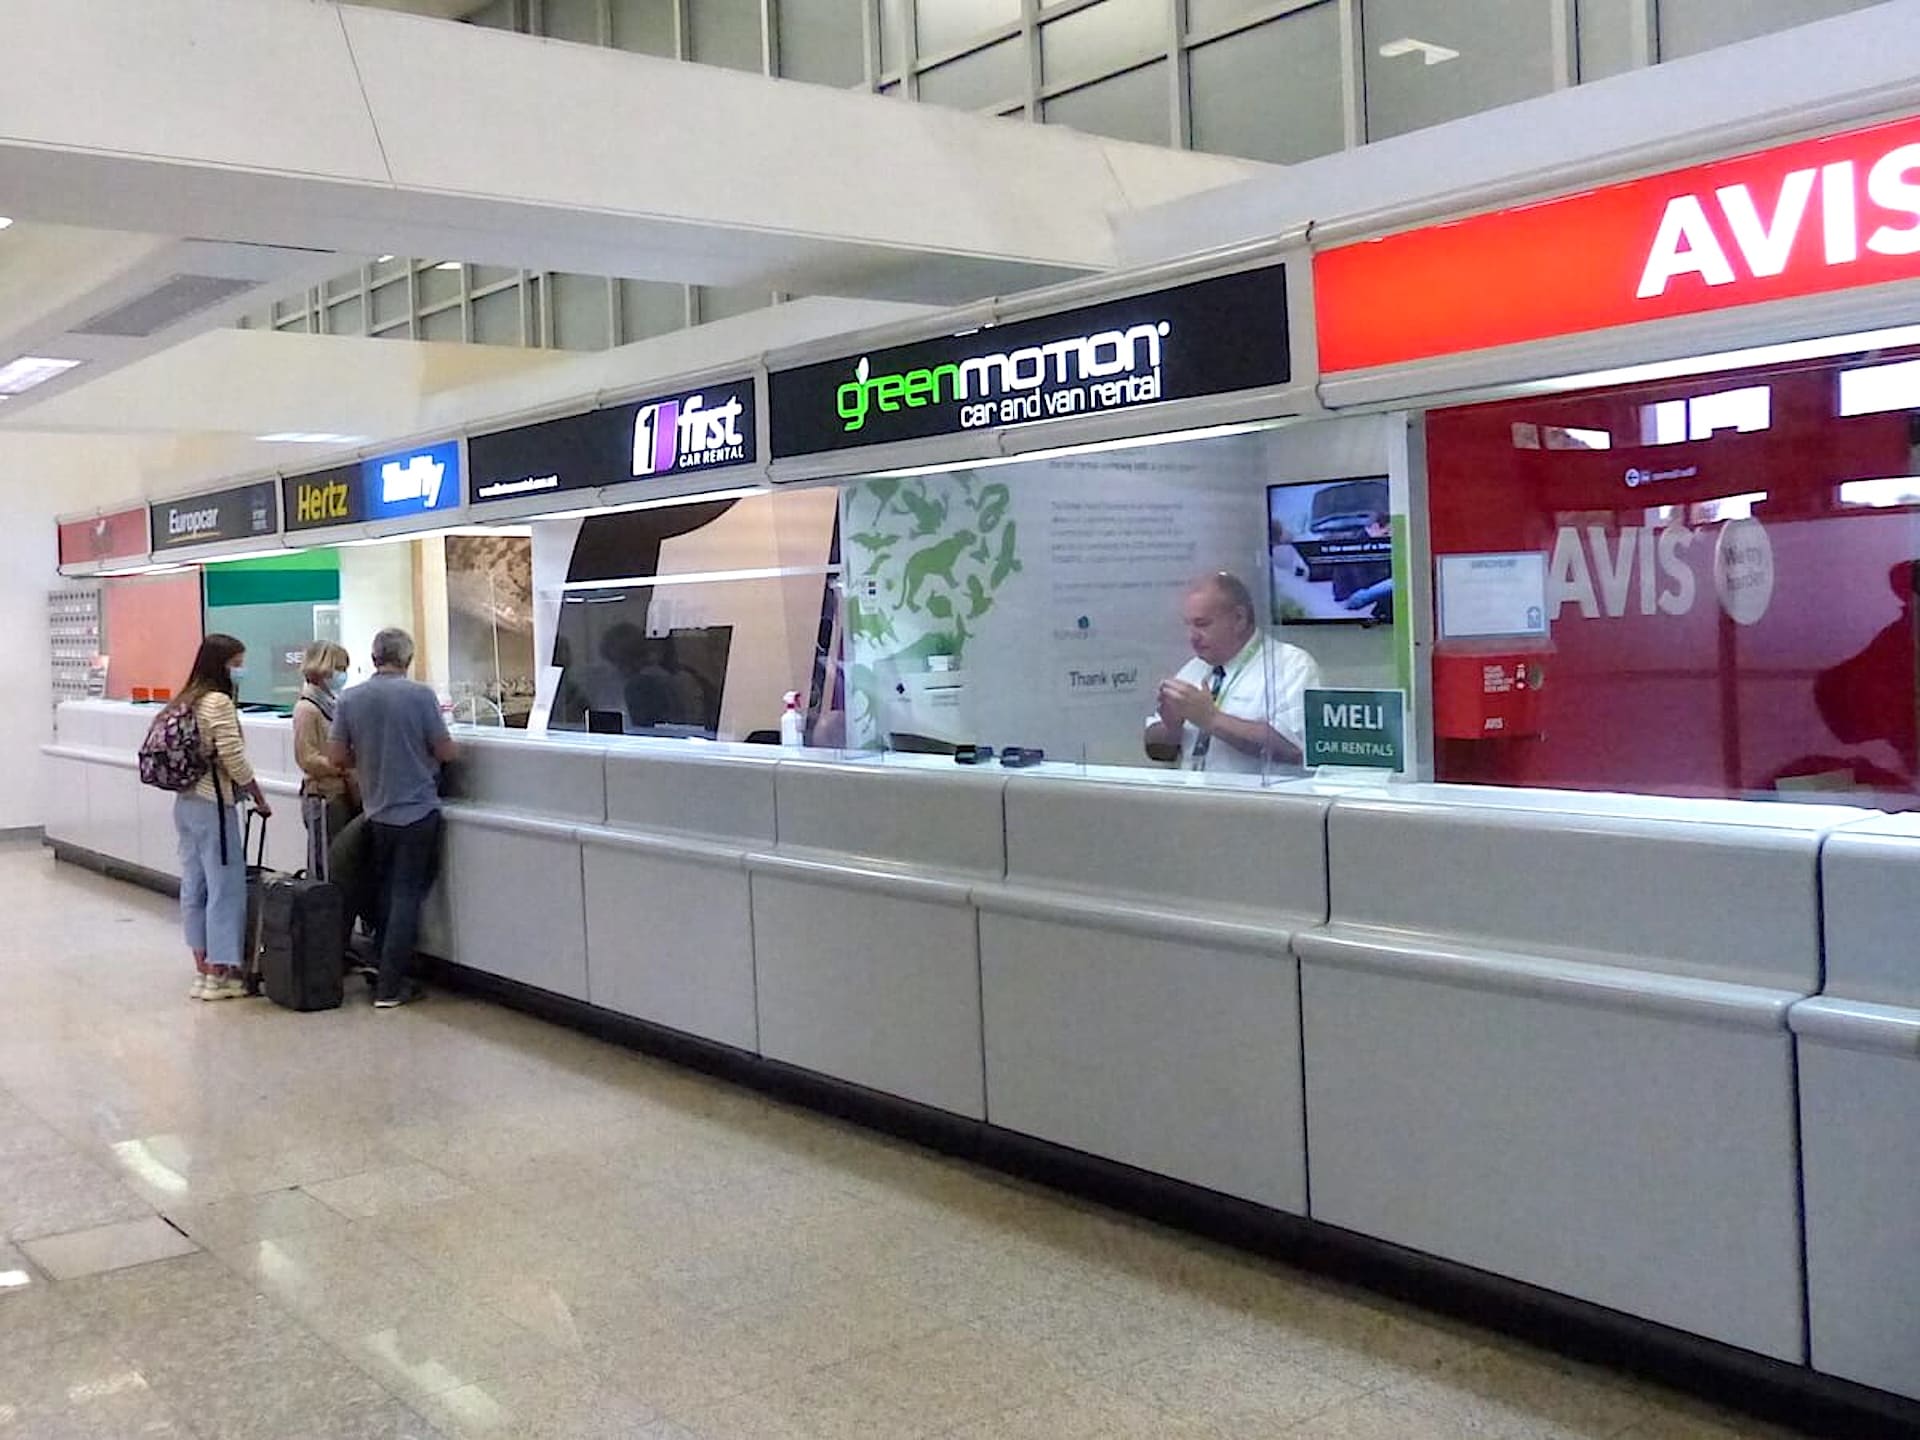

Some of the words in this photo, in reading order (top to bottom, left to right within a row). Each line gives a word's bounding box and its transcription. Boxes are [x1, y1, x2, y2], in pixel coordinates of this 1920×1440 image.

[1636, 142, 1920, 299] AVIS
[960, 404, 997, 428] car
[1000, 388, 1041, 423] and
[1044, 387, 1085, 415] van
[1091, 366, 1162, 408] rental
[677, 394, 744, 454] first
[679, 453, 702, 468] CAR
[703, 446, 744, 463] RENTAL
[297, 480, 349, 522] Hertz
[168, 507, 219, 537] Europcar
[1549, 523, 1696, 620] AVIS
[1069, 670, 1106, 687] Thank
[1323, 703, 1384, 730] MELI
[1315, 740, 1339, 754] CAR
[1342, 741, 1394, 757] RENTALS
